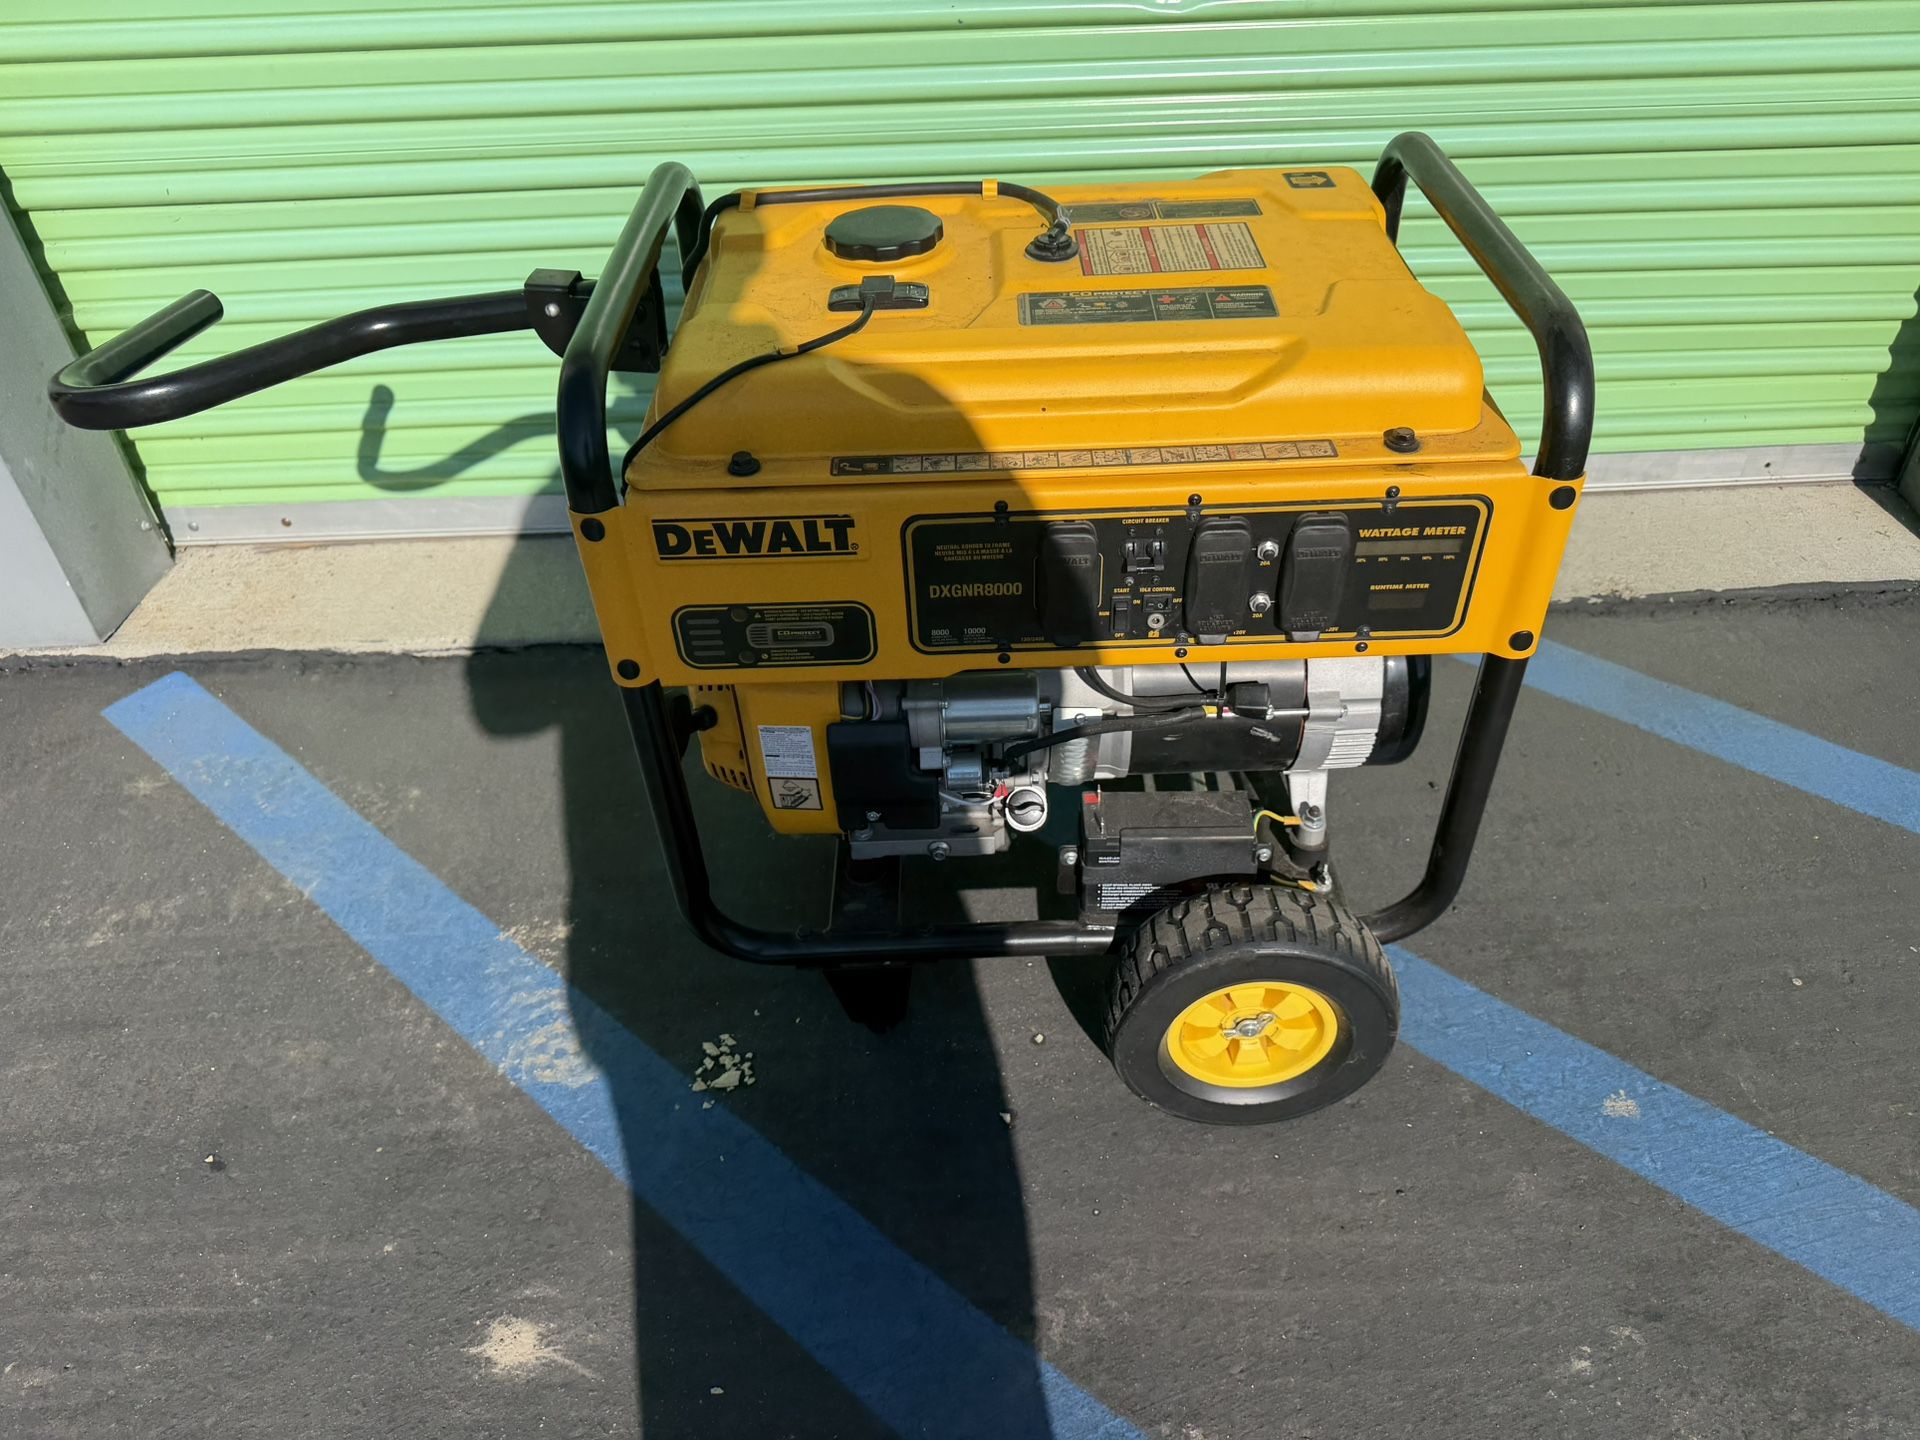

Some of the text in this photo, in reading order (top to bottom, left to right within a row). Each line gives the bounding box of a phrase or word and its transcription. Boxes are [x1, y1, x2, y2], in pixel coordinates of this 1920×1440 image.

[652, 520, 856, 556] DEWALT
[1358, 526, 1467, 538] WATTAGE METER
[929, 582, 1022, 598] DXGNR8000
[964, 627, 986, 635] 10000
